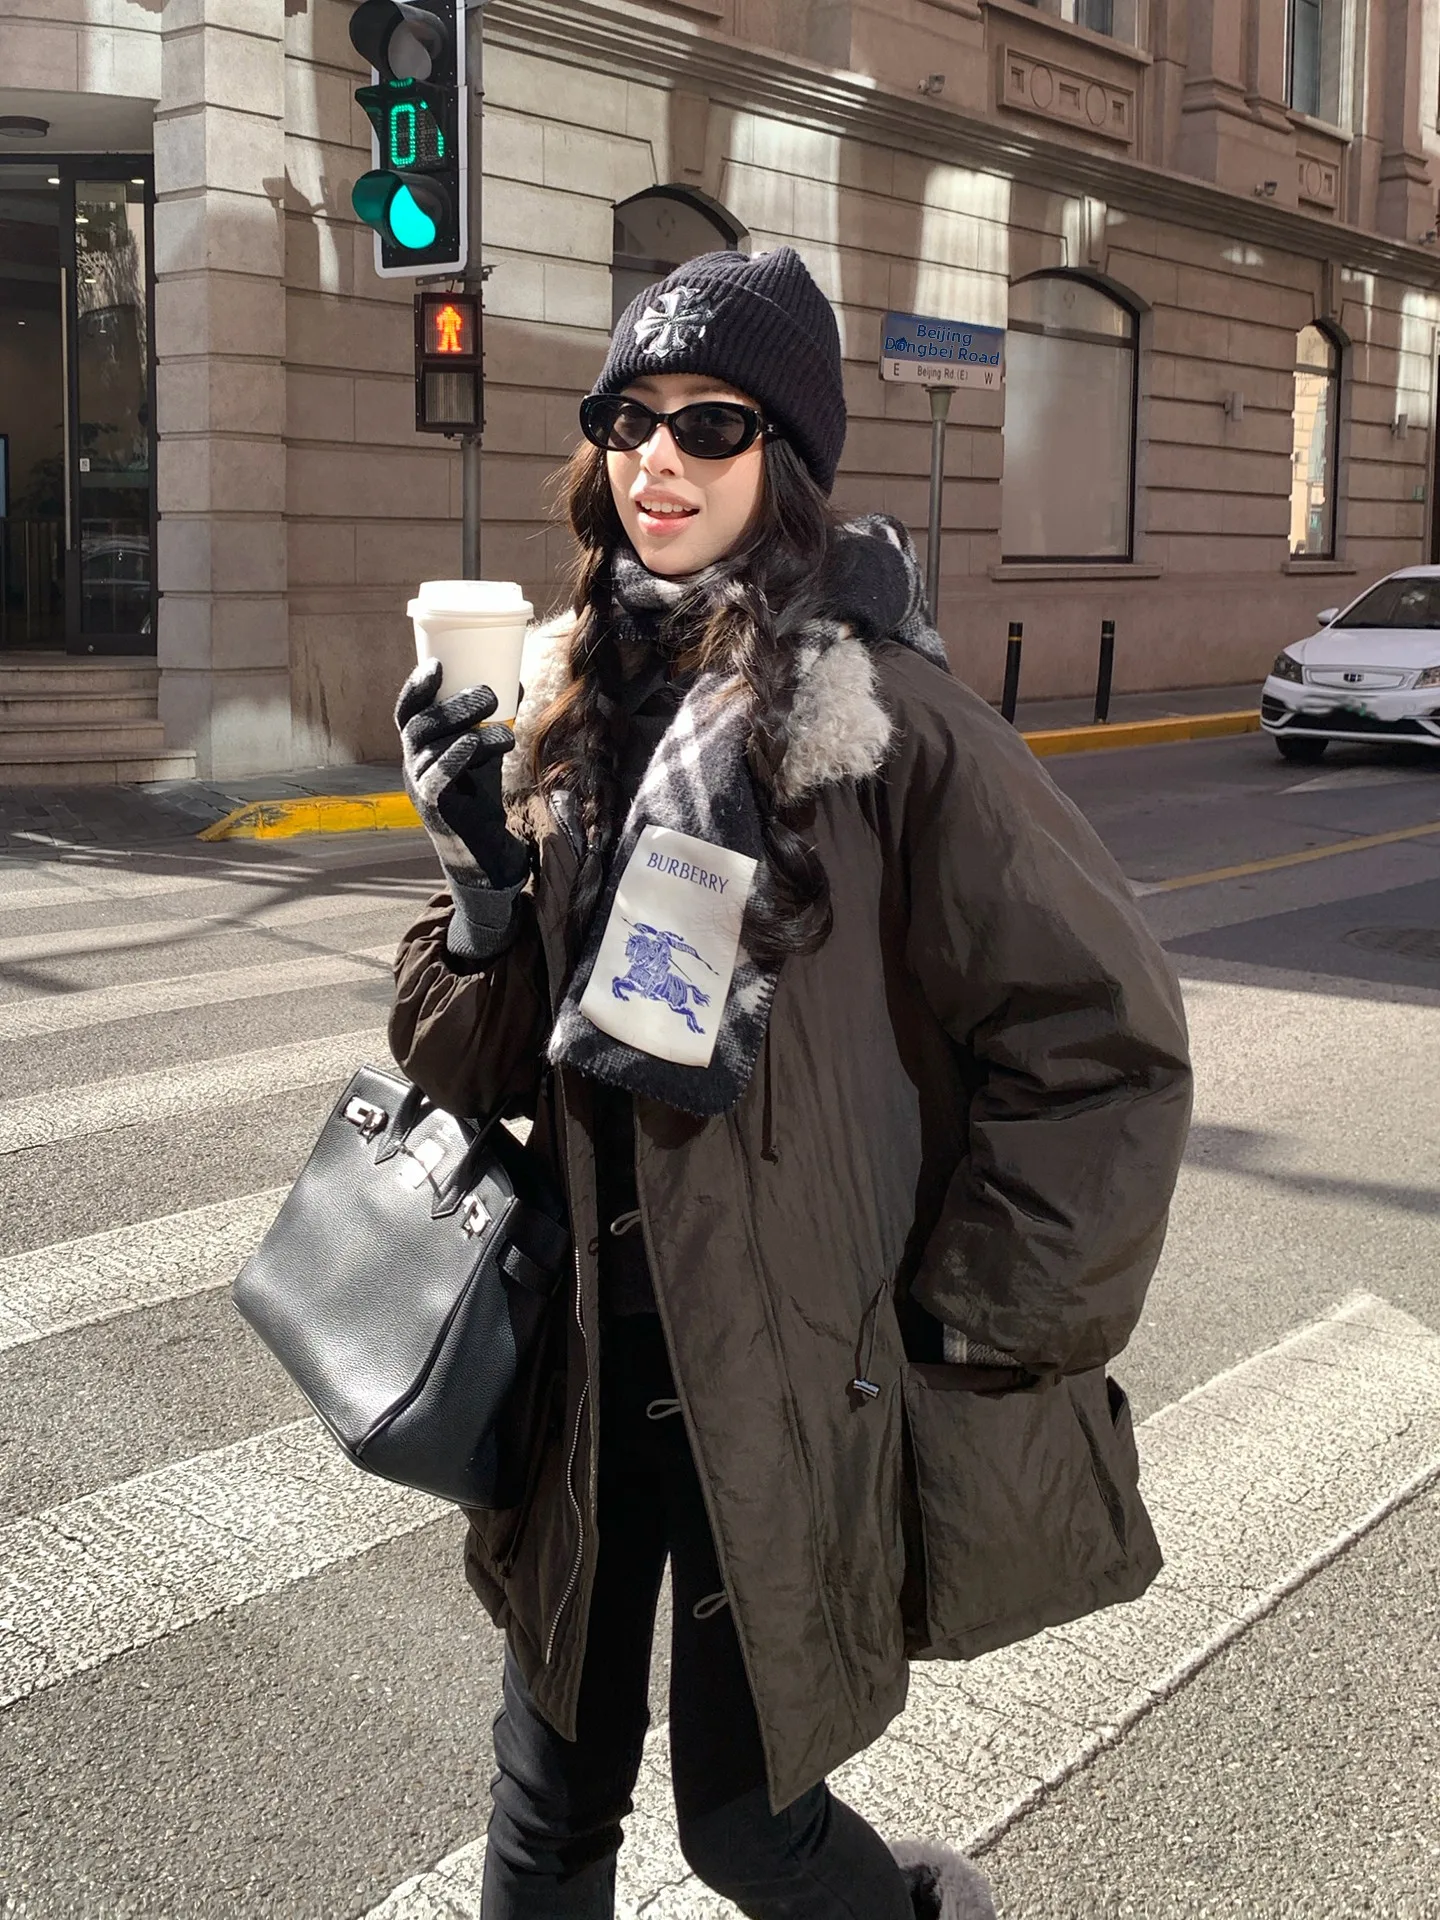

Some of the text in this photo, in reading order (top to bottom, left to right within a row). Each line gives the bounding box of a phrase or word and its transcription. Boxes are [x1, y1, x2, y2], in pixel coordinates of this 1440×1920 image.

[917, 324, 972, 347] Beijing
[957, 347, 1000, 366] Road
[893, 363, 900, 376] E
[917, 365, 942, 379] Beijing
[984, 371, 993, 385] W
[646, 852, 729, 894] BURBERRY
